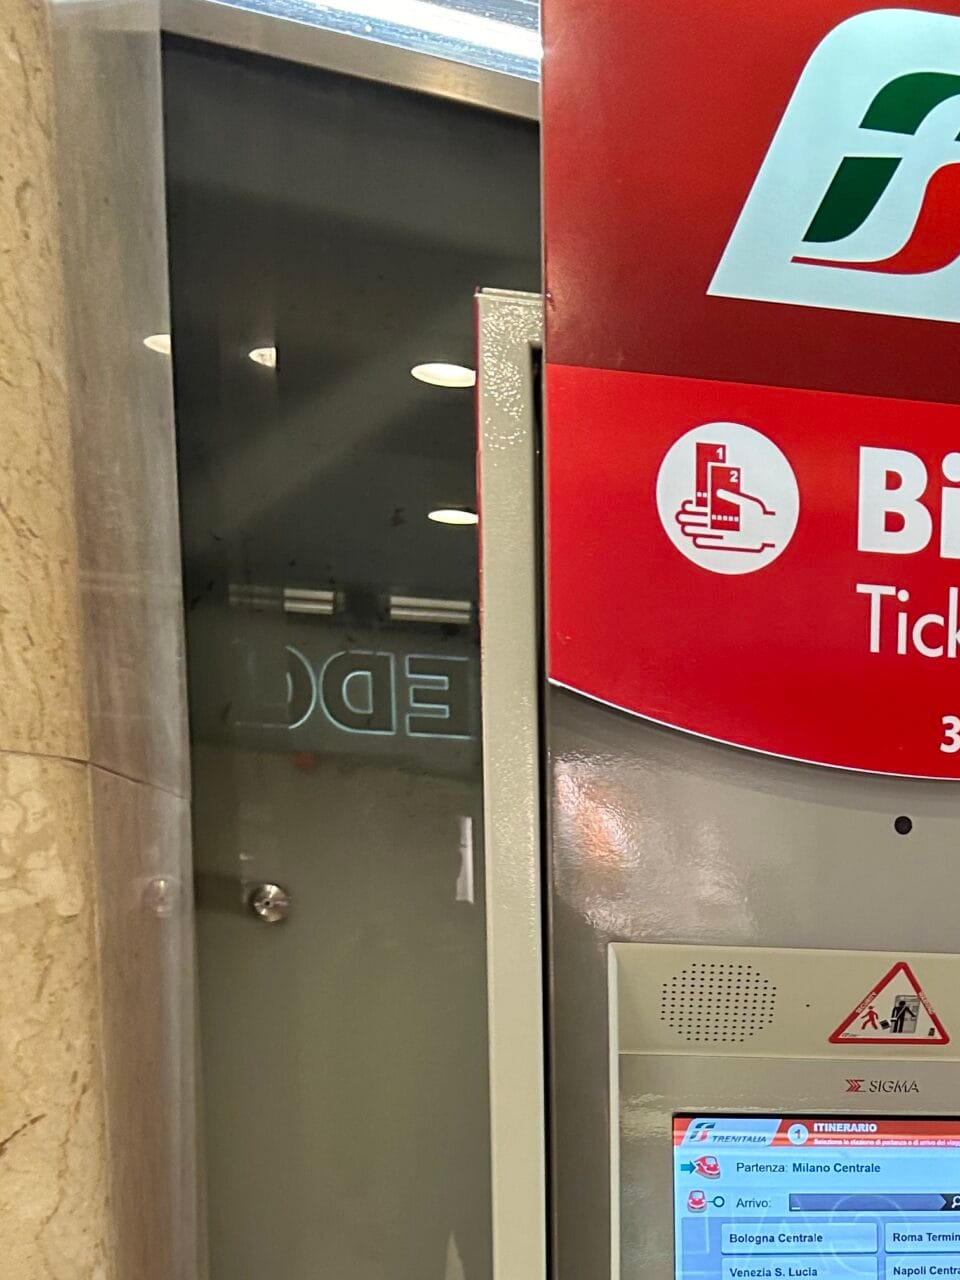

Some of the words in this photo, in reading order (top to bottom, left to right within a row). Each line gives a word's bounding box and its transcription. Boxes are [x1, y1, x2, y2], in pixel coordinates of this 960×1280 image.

[869, 1079, 921, 1093] SIGMA
[813, 1122, 878, 1132] ITINERARIO
[712, 1135, 767, 1143] TRENITALIA
[736, 1163, 788, 1173] Partenza:
[792, 1163, 831, 1173] Milano
[833, 1163, 881, 1173] Centrale
[736, 1198, 771, 1208] Arrivo:
[729, 1233, 775, 1245] Bologna
[778, 1233, 823, 1243] Centrale
[893, 1232, 923, 1242] Roma
[729, 1268, 772, 1277] Venezia
[774, 1267, 786, 1277] S.
[788, 1267, 818, 1277] Lucia
[893, 1266, 926, 1277] Napoli
